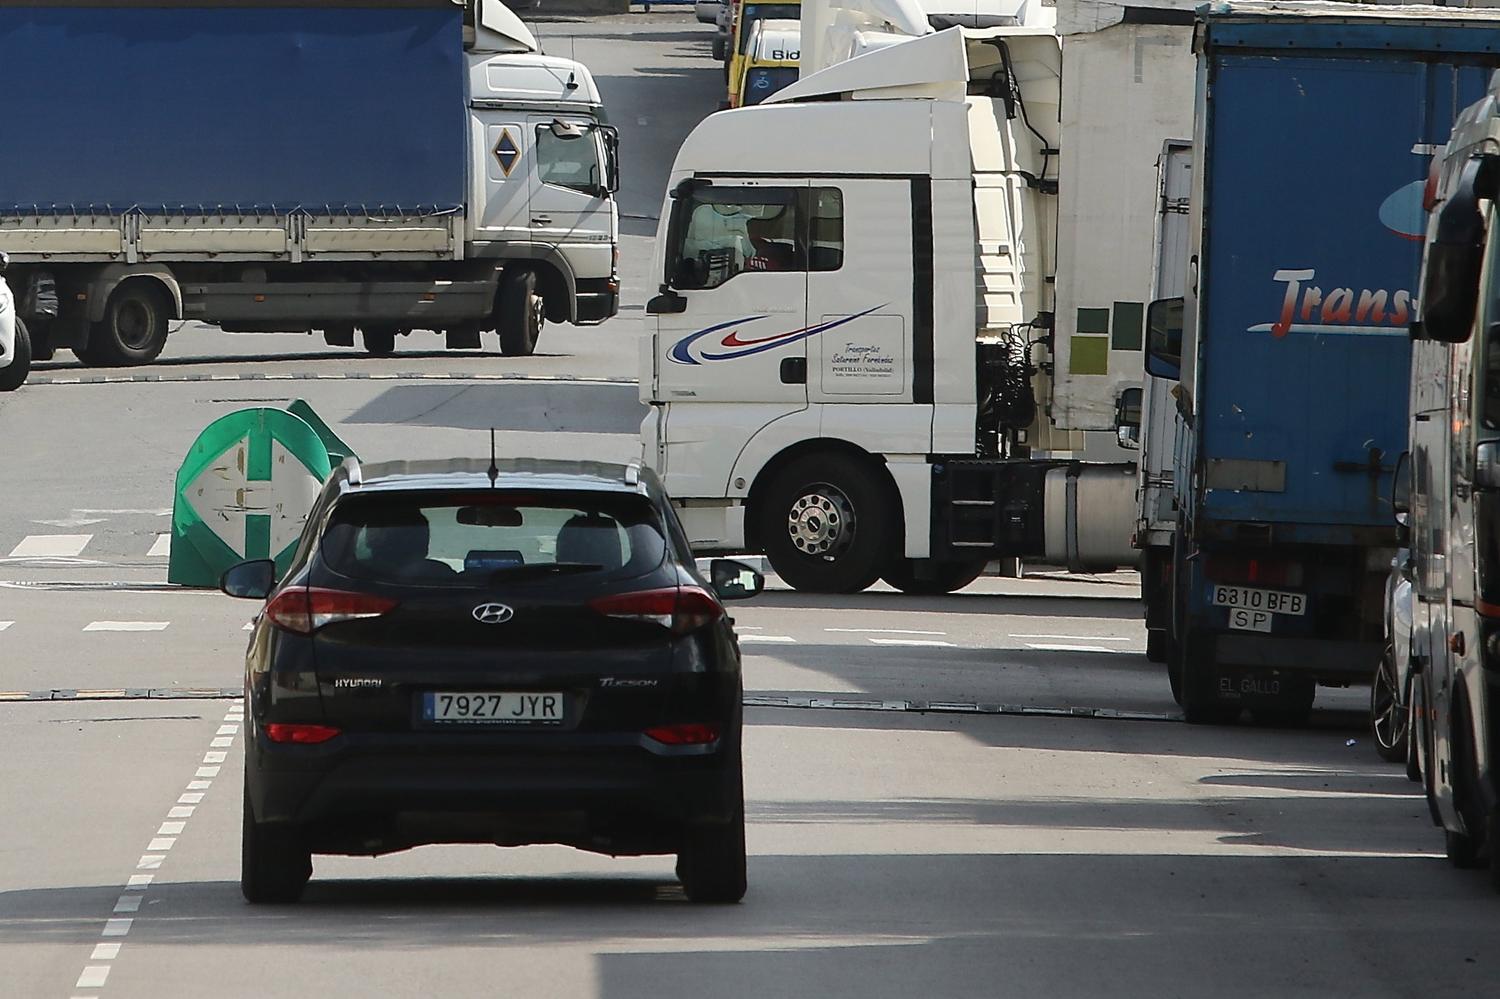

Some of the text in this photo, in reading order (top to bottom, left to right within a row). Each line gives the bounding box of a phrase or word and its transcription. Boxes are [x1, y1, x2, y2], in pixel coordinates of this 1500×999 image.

[1271, 269, 1411, 339] Trans
[1216, 587, 1302, 613] 6310 BFB
[335, 678, 382, 688] HYUNDAI
[1220, 677, 1280, 694] EL GALLO
[440, 695, 556, 717] 7927 JYR
